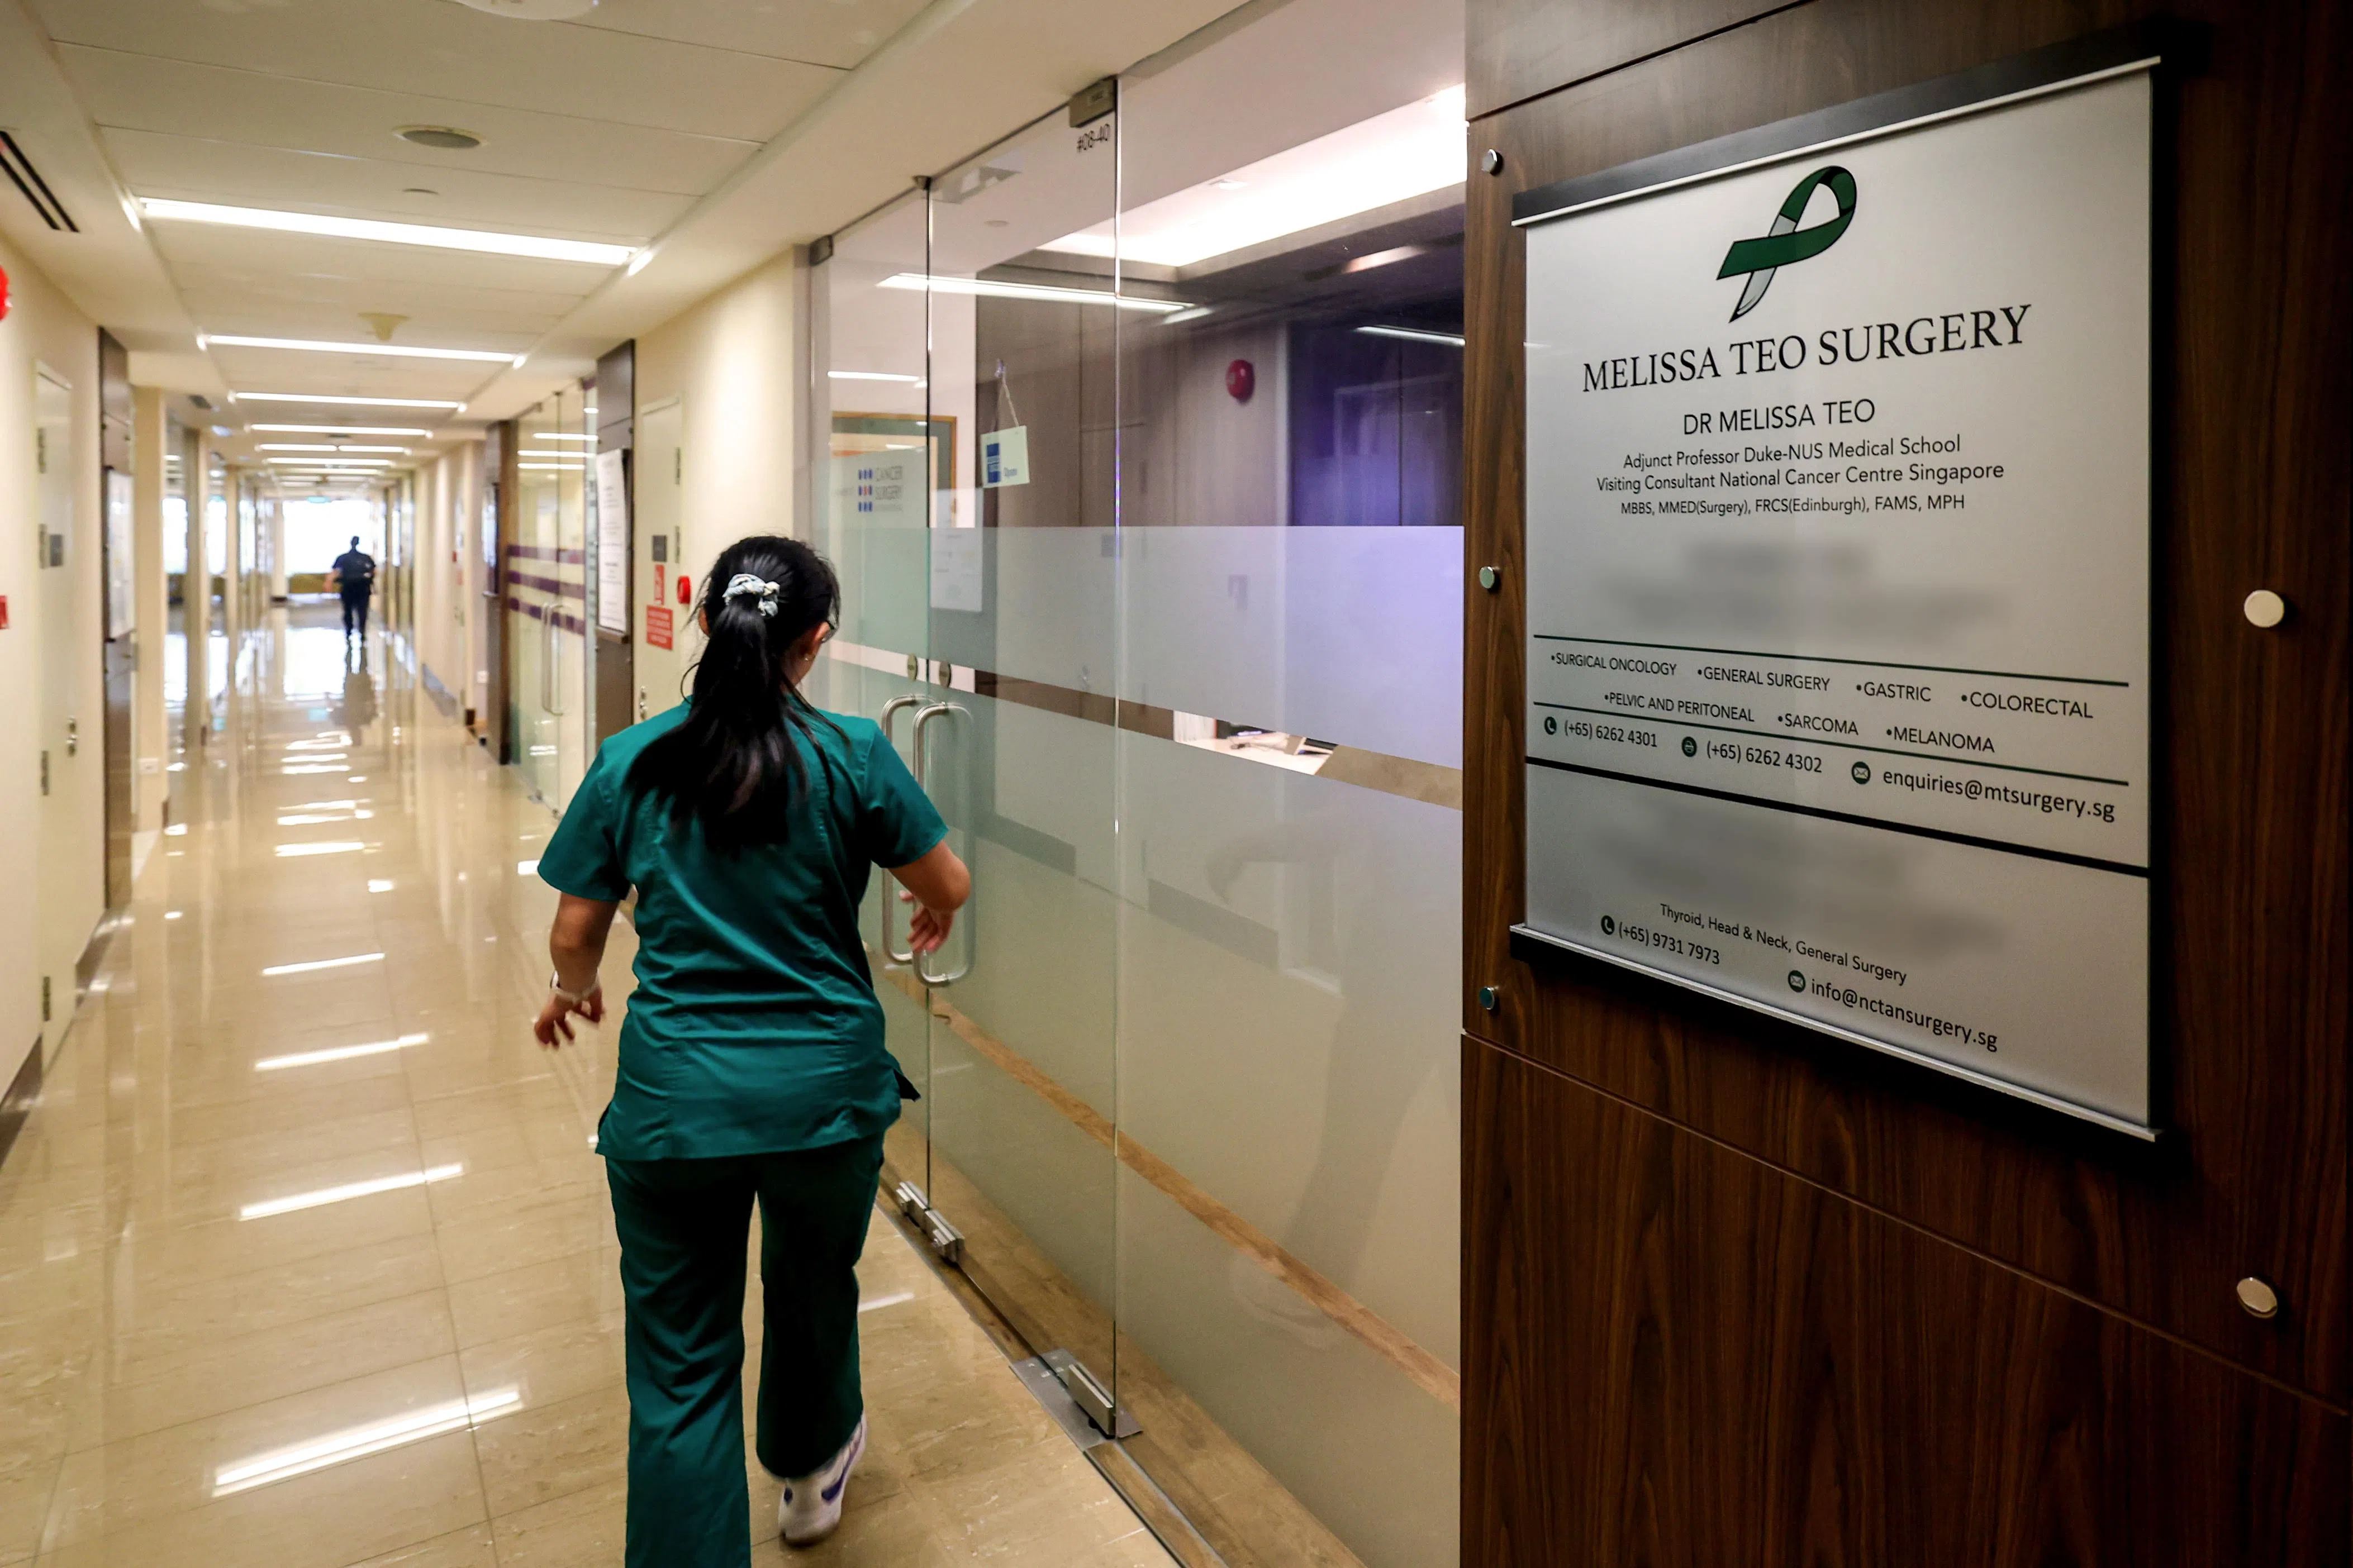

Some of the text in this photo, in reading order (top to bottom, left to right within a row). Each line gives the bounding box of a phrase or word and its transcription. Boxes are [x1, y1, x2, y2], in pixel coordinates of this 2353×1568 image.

[1582, 303, 2032, 393] MELISSA TEO SURGERY
[1684, 398, 1875, 435] DR MELISSA TEO
[1623, 433, 1960, 472] Adjunct Professor Duke-NUS Medical School
[1596, 463, 2004, 494] Visiting Consultant National Cancer Centre Singapore
[1621, 494, 1965, 517] MBBS, MMED(Surgery), FRCS(Edinburgh), FAMS, MPH
[1609, 657, 1677, 675] ONCOLOGY
[1766, 672, 1831, 692] SURGERY
[1647, 697, 1675, 712] AND
[1677, 700, 1755, 722] PERITONEAL
[1564, 719, 1658, 748] (+65) 6262 4301
[1706, 740, 1822, 773] (+65) 6262 4302
[1883, 771, 2115, 823] enquiries@mtsurgery.sg
[1618, 921, 1720, 965] (+65) 9731 7973
[1660, 903, 1907, 986] Thyroid, Head & Neck, General Surgery
[1810, 978, 1998, 1053] info@nctansurgery.sg
